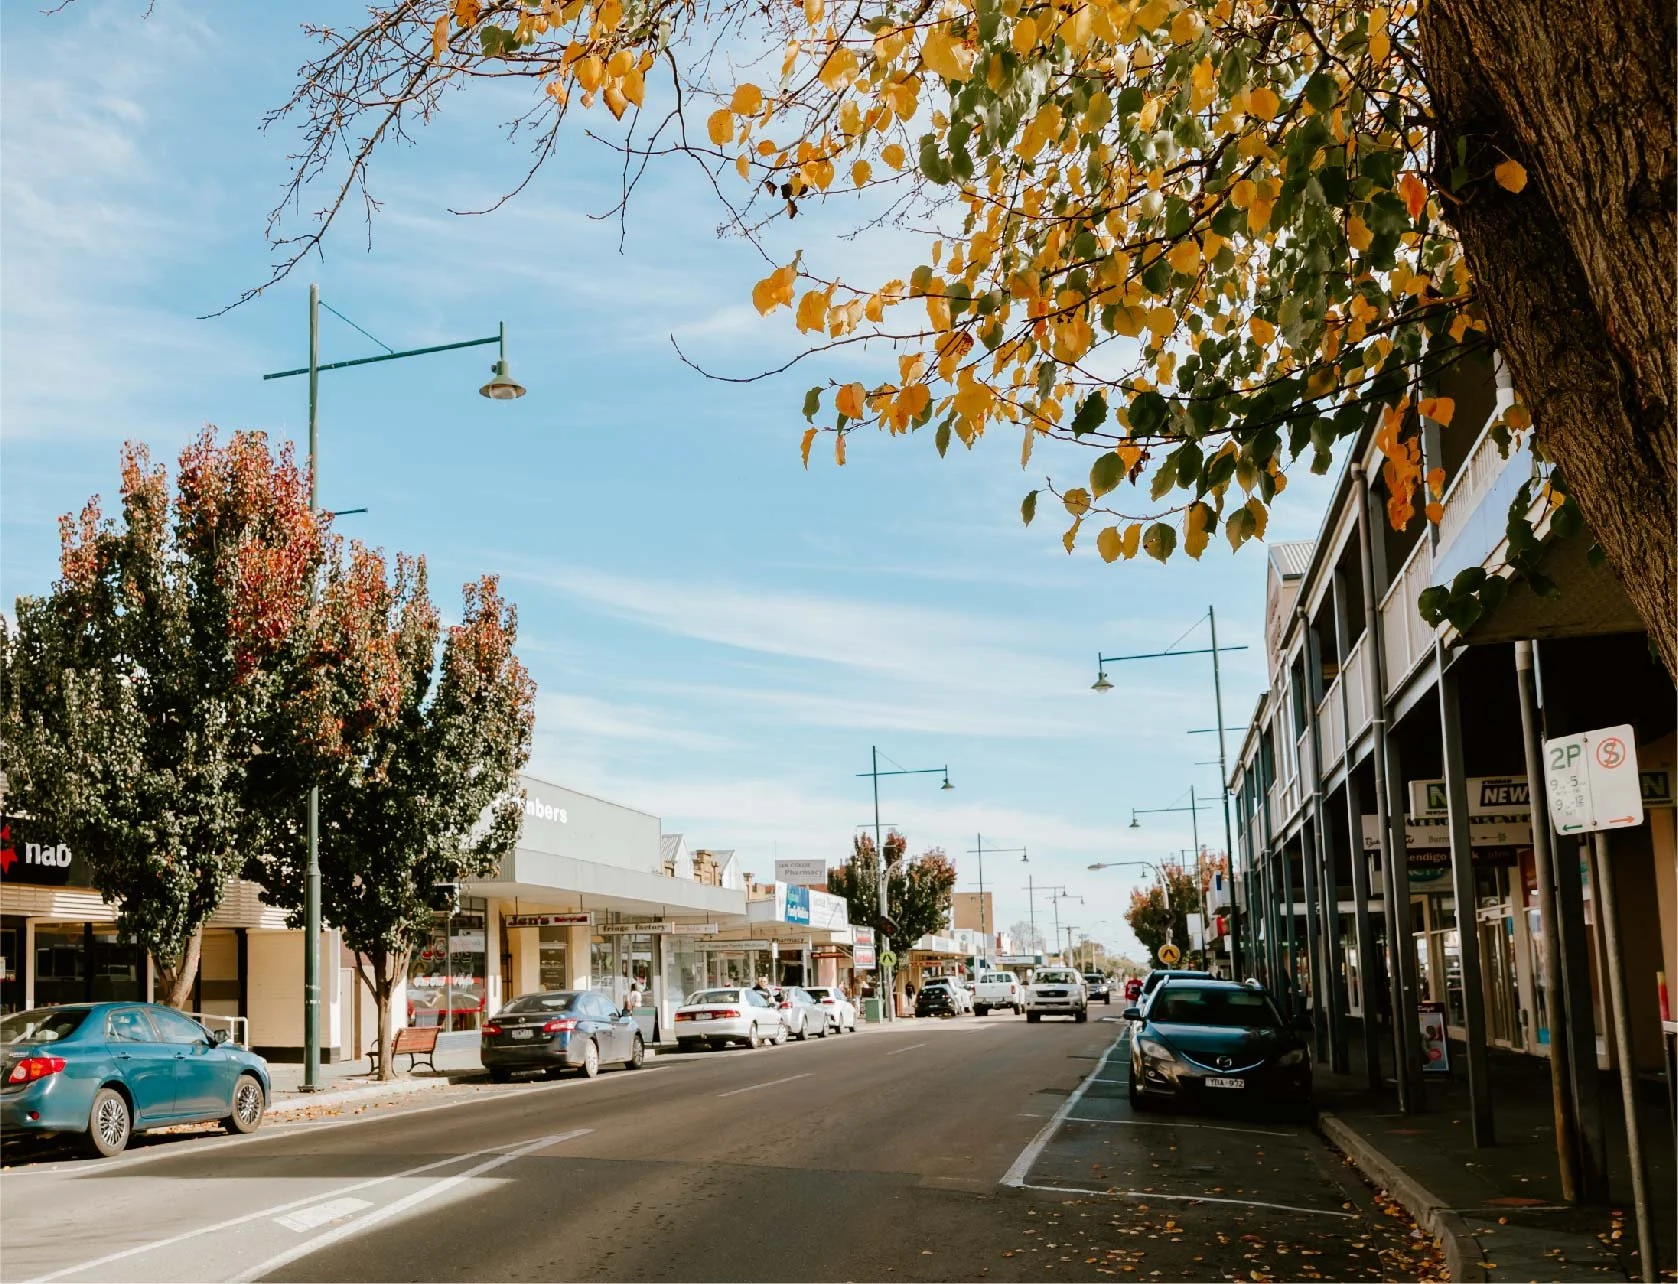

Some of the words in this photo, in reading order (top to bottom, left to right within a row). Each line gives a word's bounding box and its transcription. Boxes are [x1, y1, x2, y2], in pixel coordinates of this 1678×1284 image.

[1550, 744, 1581, 770] 2P
[1484, 786, 1530, 804] NEW
[25, 841, 72, 868] nab
[1408, 851, 1447, 863] endigo
[784, 869, 823, 877] Pharmacy
